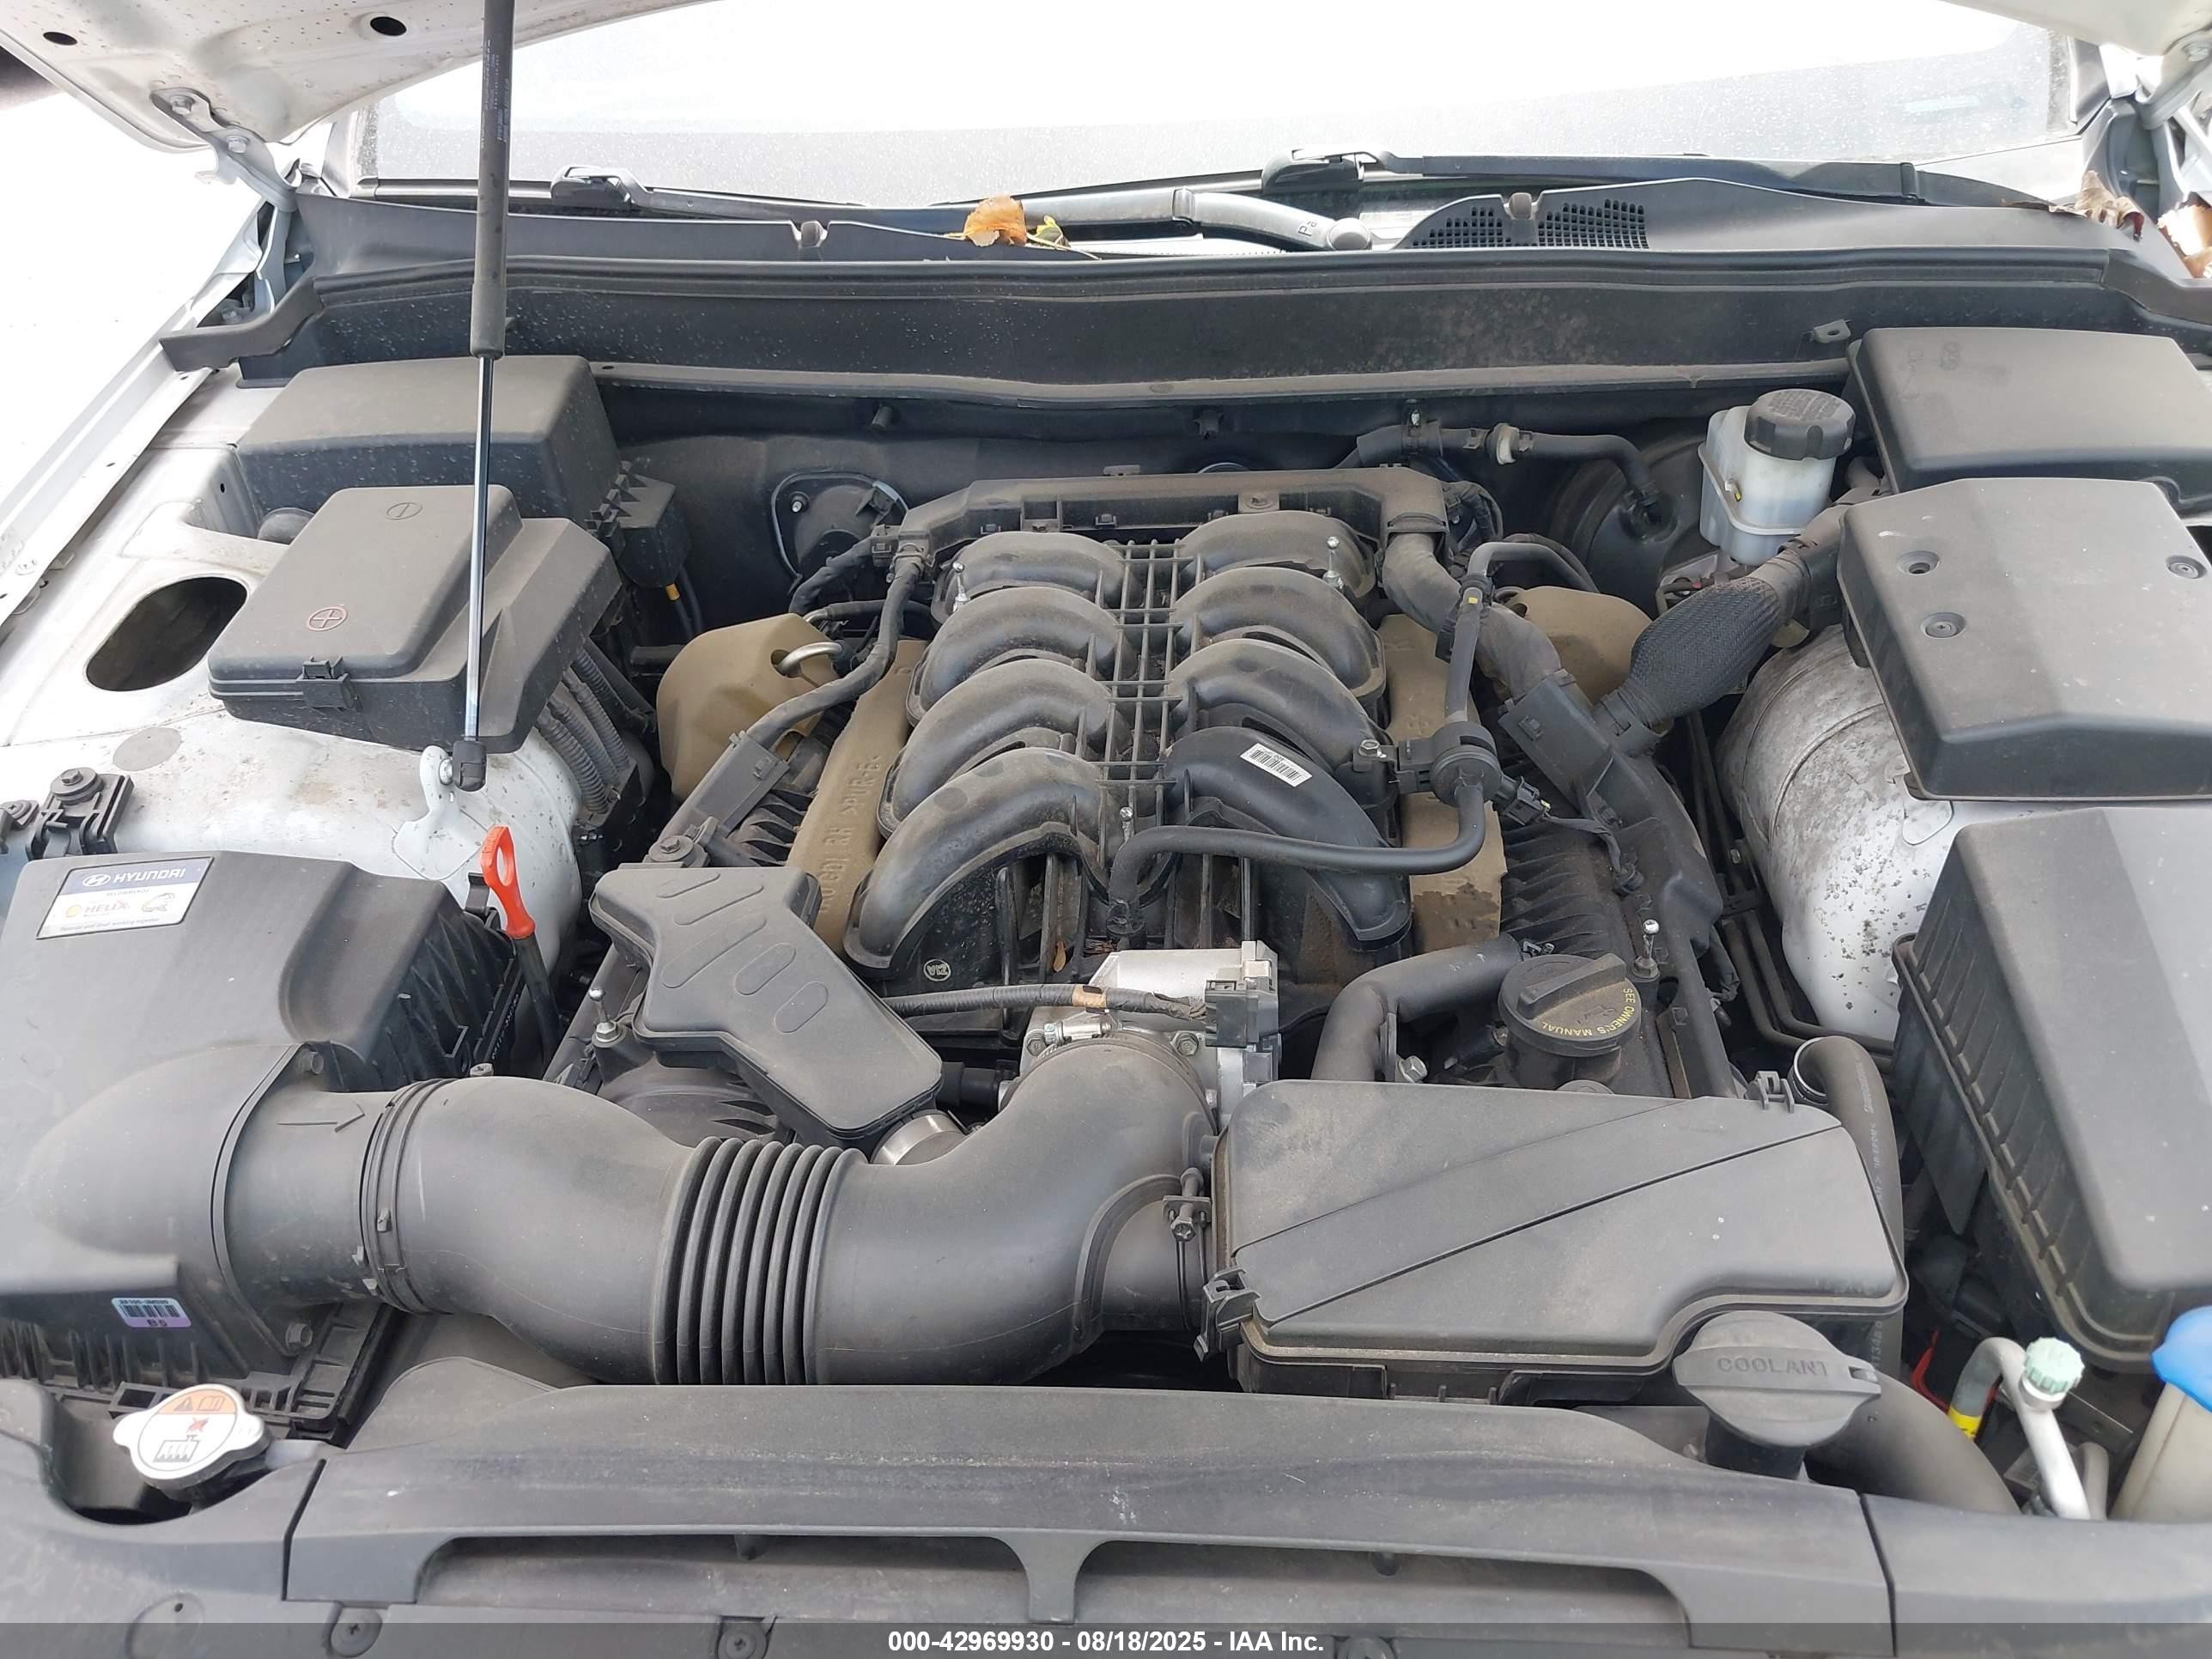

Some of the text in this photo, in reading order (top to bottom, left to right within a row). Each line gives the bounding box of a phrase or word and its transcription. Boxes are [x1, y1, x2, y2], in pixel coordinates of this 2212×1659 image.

[112, 867, 186, 884] HYUNDAI
[1541, 988, 1636, 1036] SEE OWNER'S MANUAL
[1718, 1358, 1828, 1376] COOLANT
